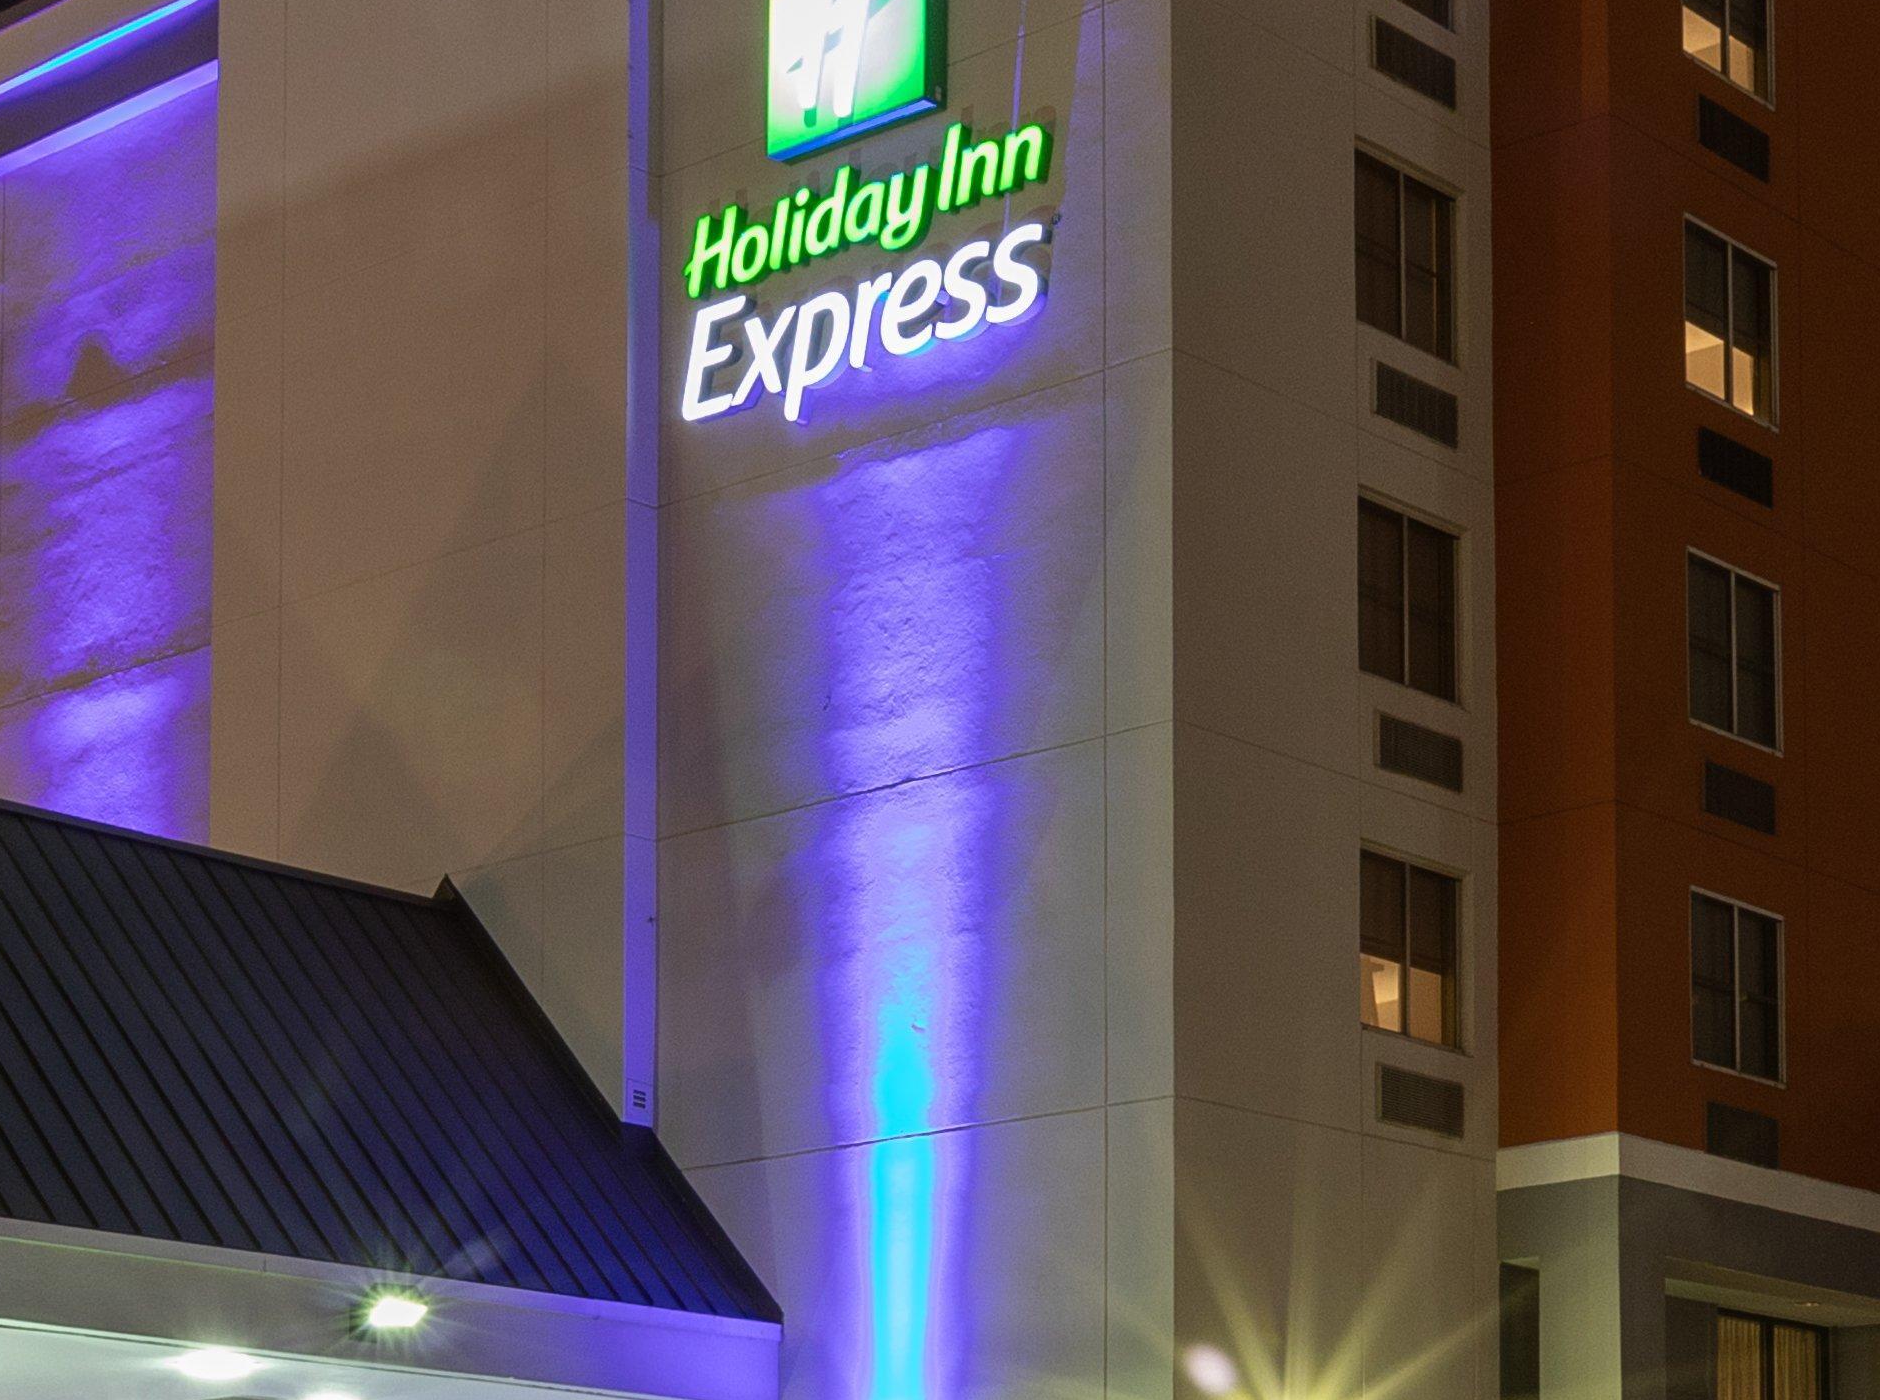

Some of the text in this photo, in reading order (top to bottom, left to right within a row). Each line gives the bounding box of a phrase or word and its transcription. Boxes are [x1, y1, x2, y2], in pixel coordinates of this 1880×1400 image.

[685, 121, 1051, 299] Holiday Inn
[681, 222, 1043, 423] Express
